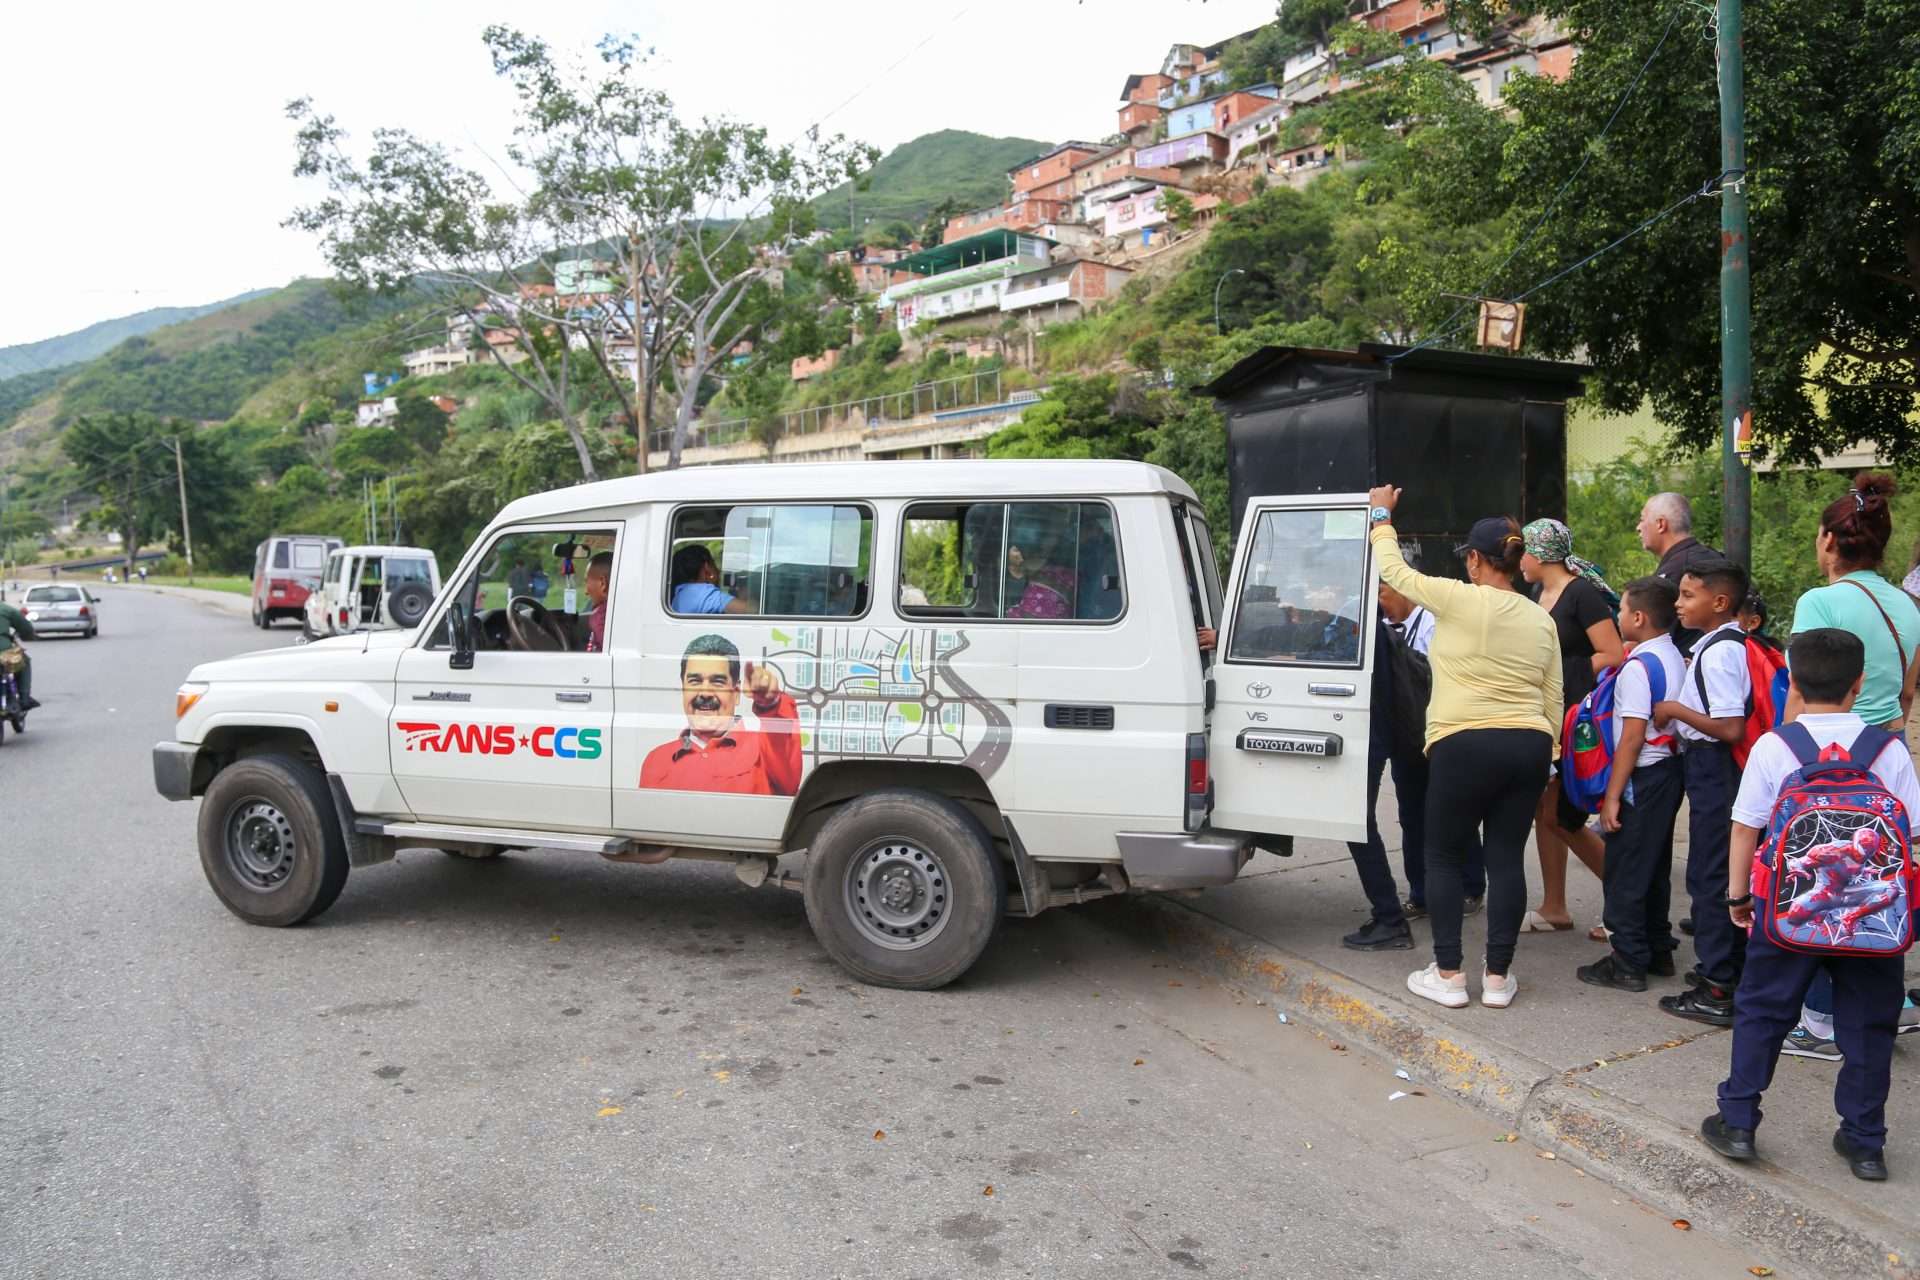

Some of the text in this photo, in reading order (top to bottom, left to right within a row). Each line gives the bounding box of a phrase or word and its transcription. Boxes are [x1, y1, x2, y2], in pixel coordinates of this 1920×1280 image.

[1246, 711, 1268, 721] V6
[532, 726, 602, 759] CCS
[1248, 739, 1324, 752] TOYOTA 4WD
